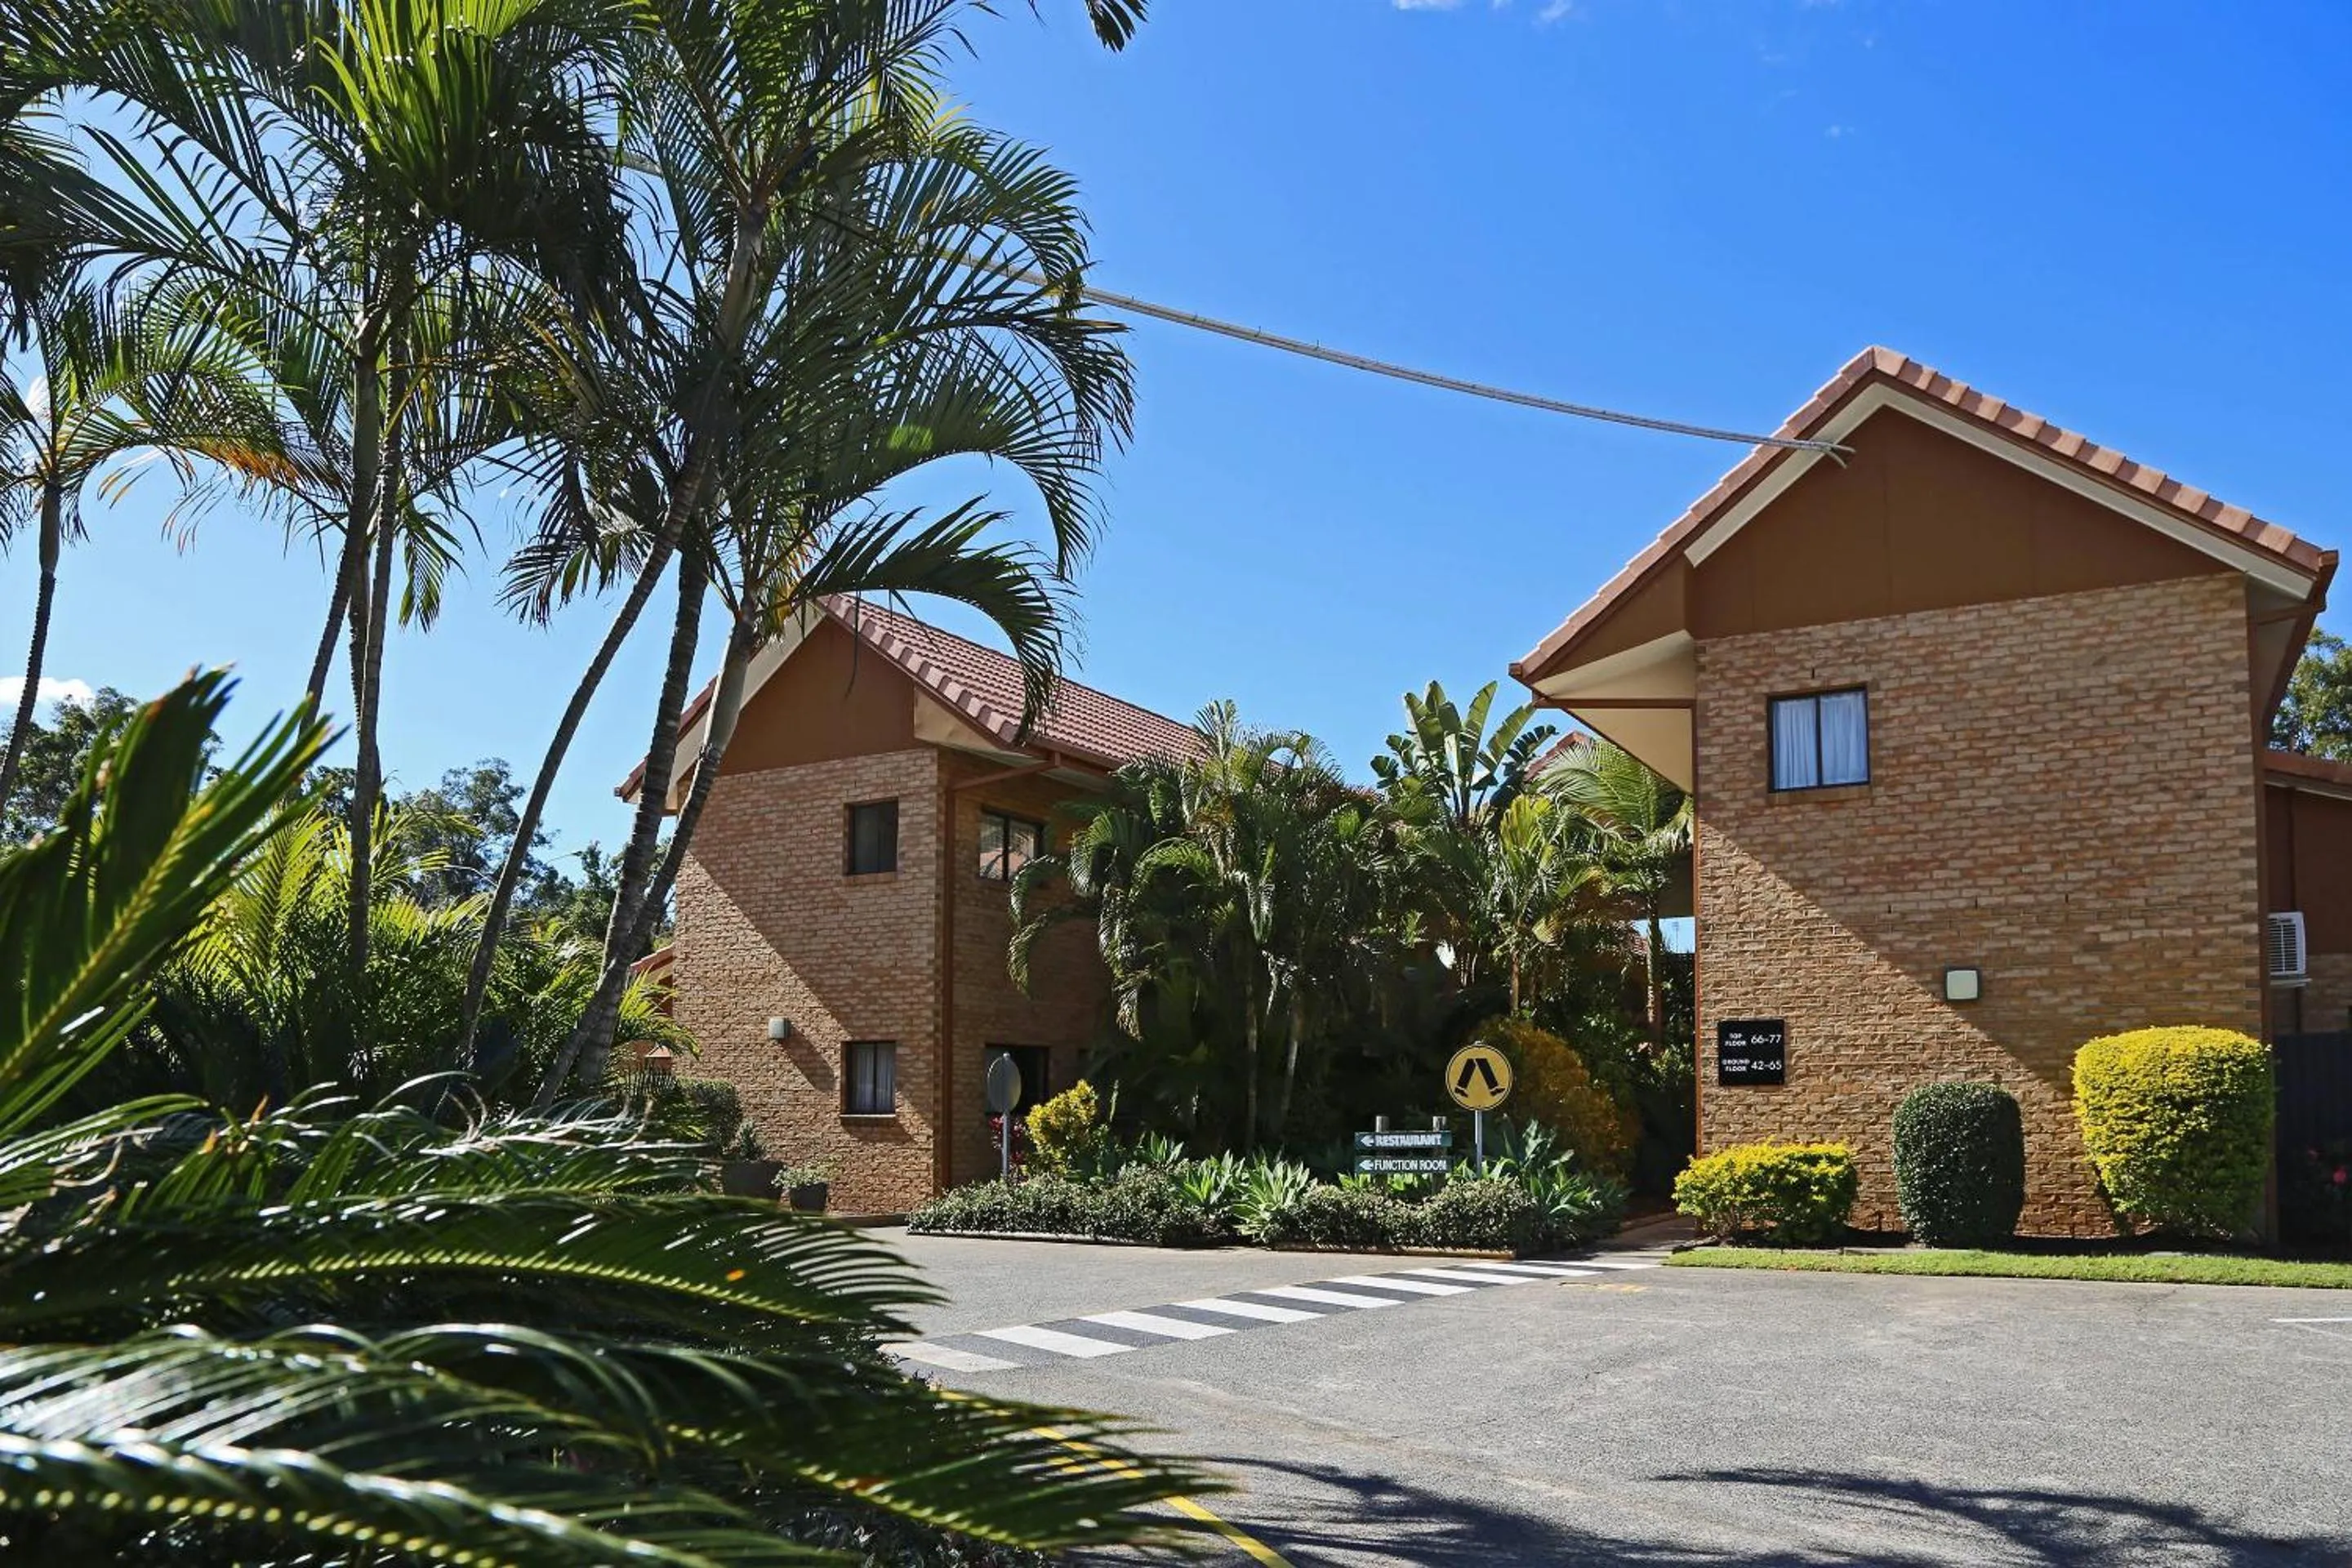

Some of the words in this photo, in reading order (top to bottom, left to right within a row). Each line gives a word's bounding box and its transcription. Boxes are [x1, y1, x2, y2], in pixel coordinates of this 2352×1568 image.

[1750, 1034, 1782, 1045] 66-77
[1750, 1060, 1782, 1071] 42-65
[1374, 1134, 1441, 1147] RESTAURANT
[1374, 1160, 1418, 1170] FUNCTION
[1419, 1160, 1446, 1170] ROOM
